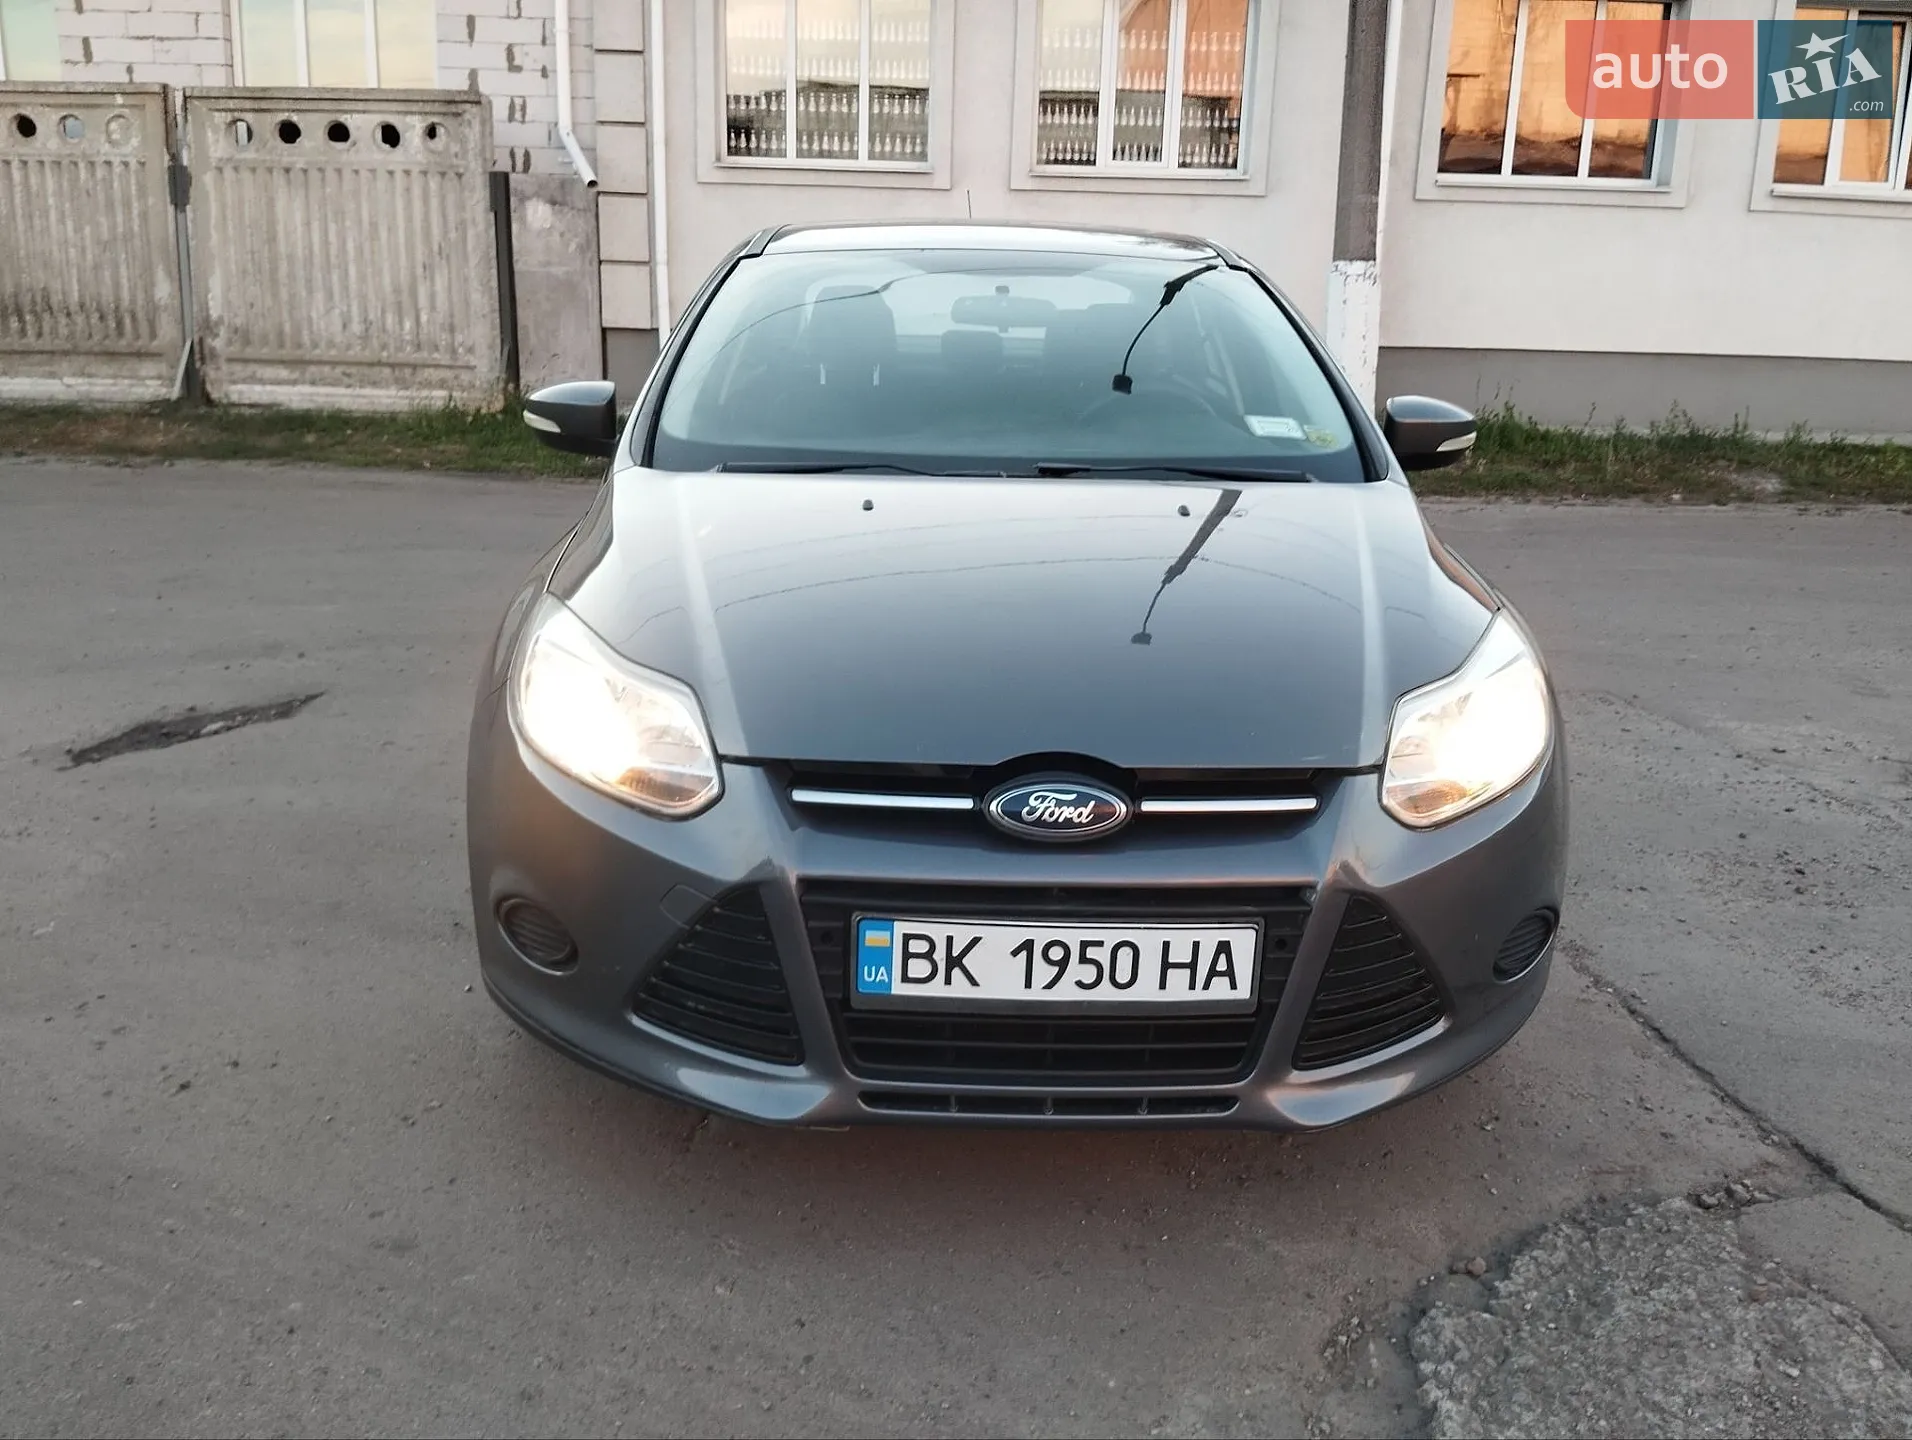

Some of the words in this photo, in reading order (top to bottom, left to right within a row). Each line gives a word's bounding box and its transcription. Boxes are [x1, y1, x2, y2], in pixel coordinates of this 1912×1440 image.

[1021, 791, 1096, 824] Ford
[863, 966, 889, 983] UA
[900, 932, 983, 988] BK
[1009, 938, 1141, 991] 1950
[1158, 939, 1239, 991] HA
